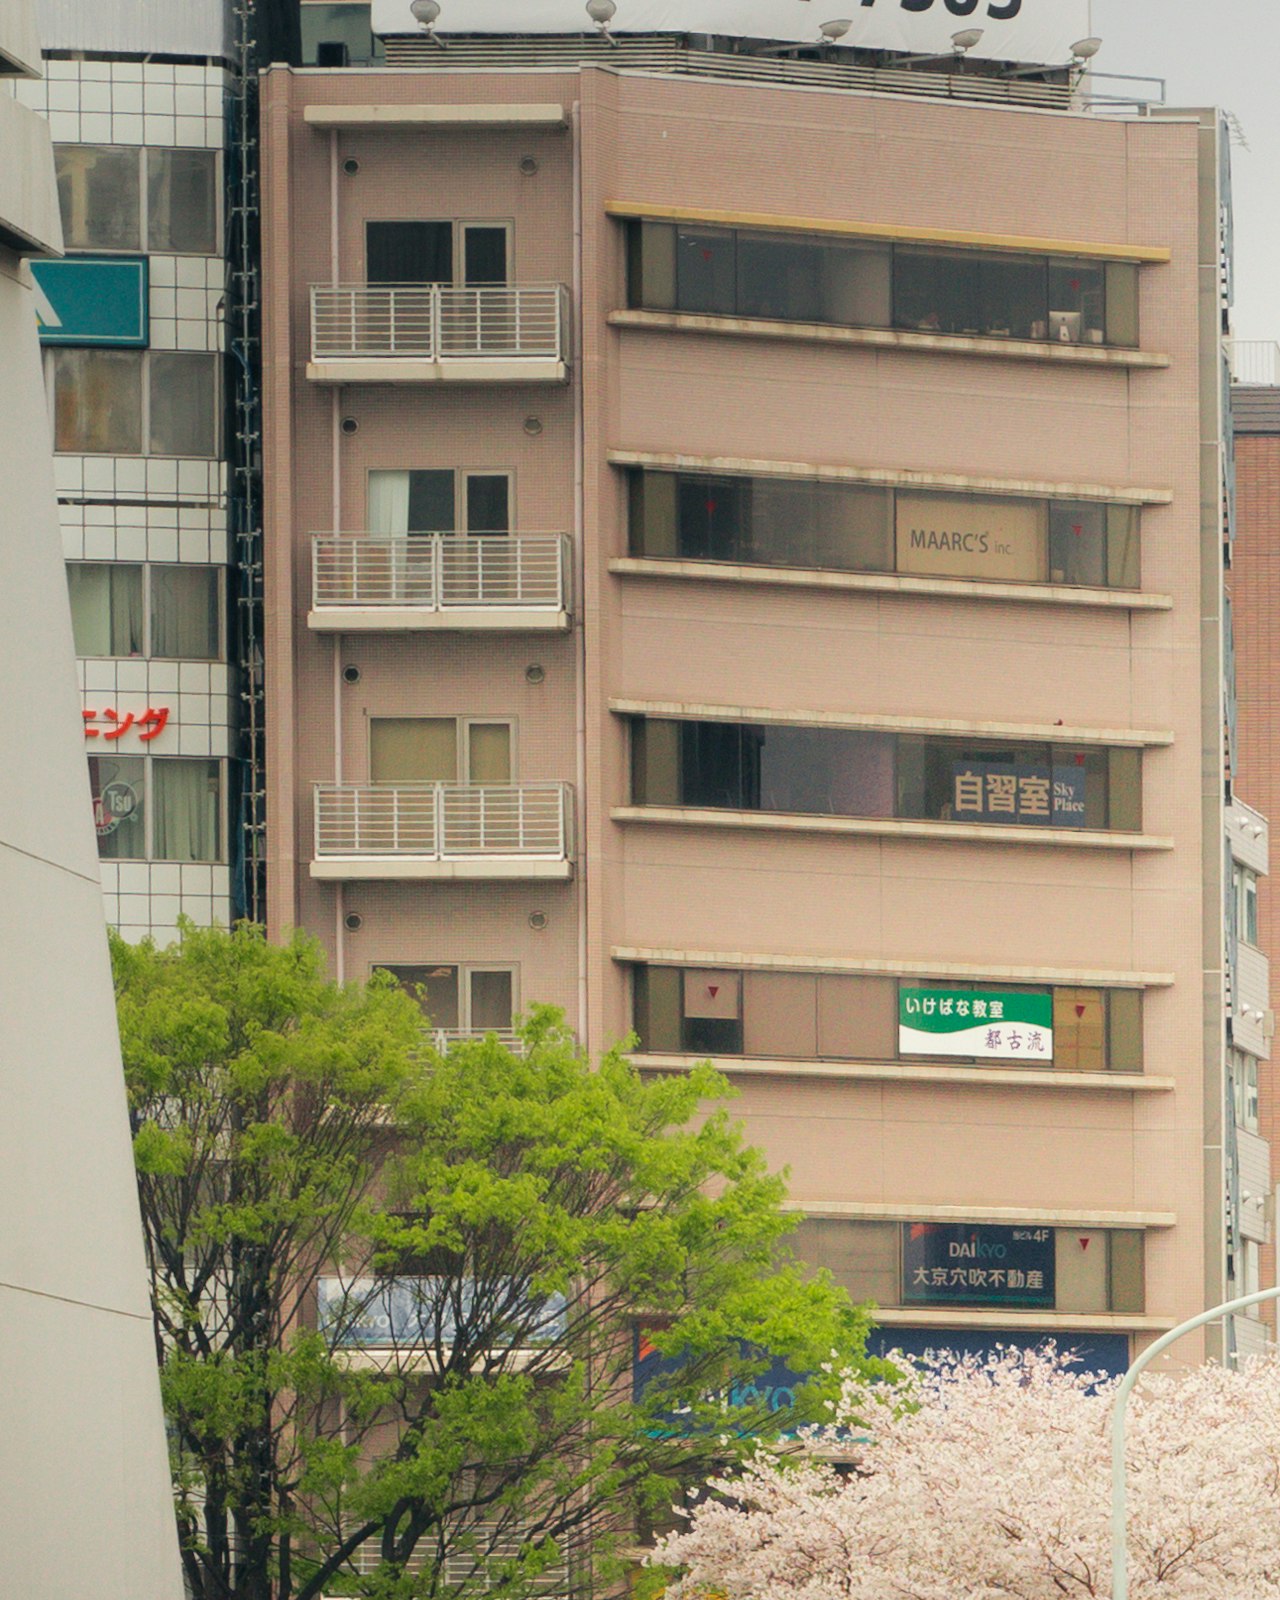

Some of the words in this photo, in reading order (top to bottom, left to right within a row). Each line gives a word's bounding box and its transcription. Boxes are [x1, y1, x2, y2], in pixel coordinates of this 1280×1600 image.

[911, 530, 988, 553] MAARC'S
[955, 771, 1050, 816] 自習室
[1054, 781, 1074, 797] Sky
[1054, 797, 1085, 812] Place
[905, 997, 1004, 1019] いけばな教室
[984, 1028, 1045, 1053] 都古流
[1028, 1229, 1049, 1242] 4F
[913, 1267, 1044, 1289] 大京穴吹不動産
